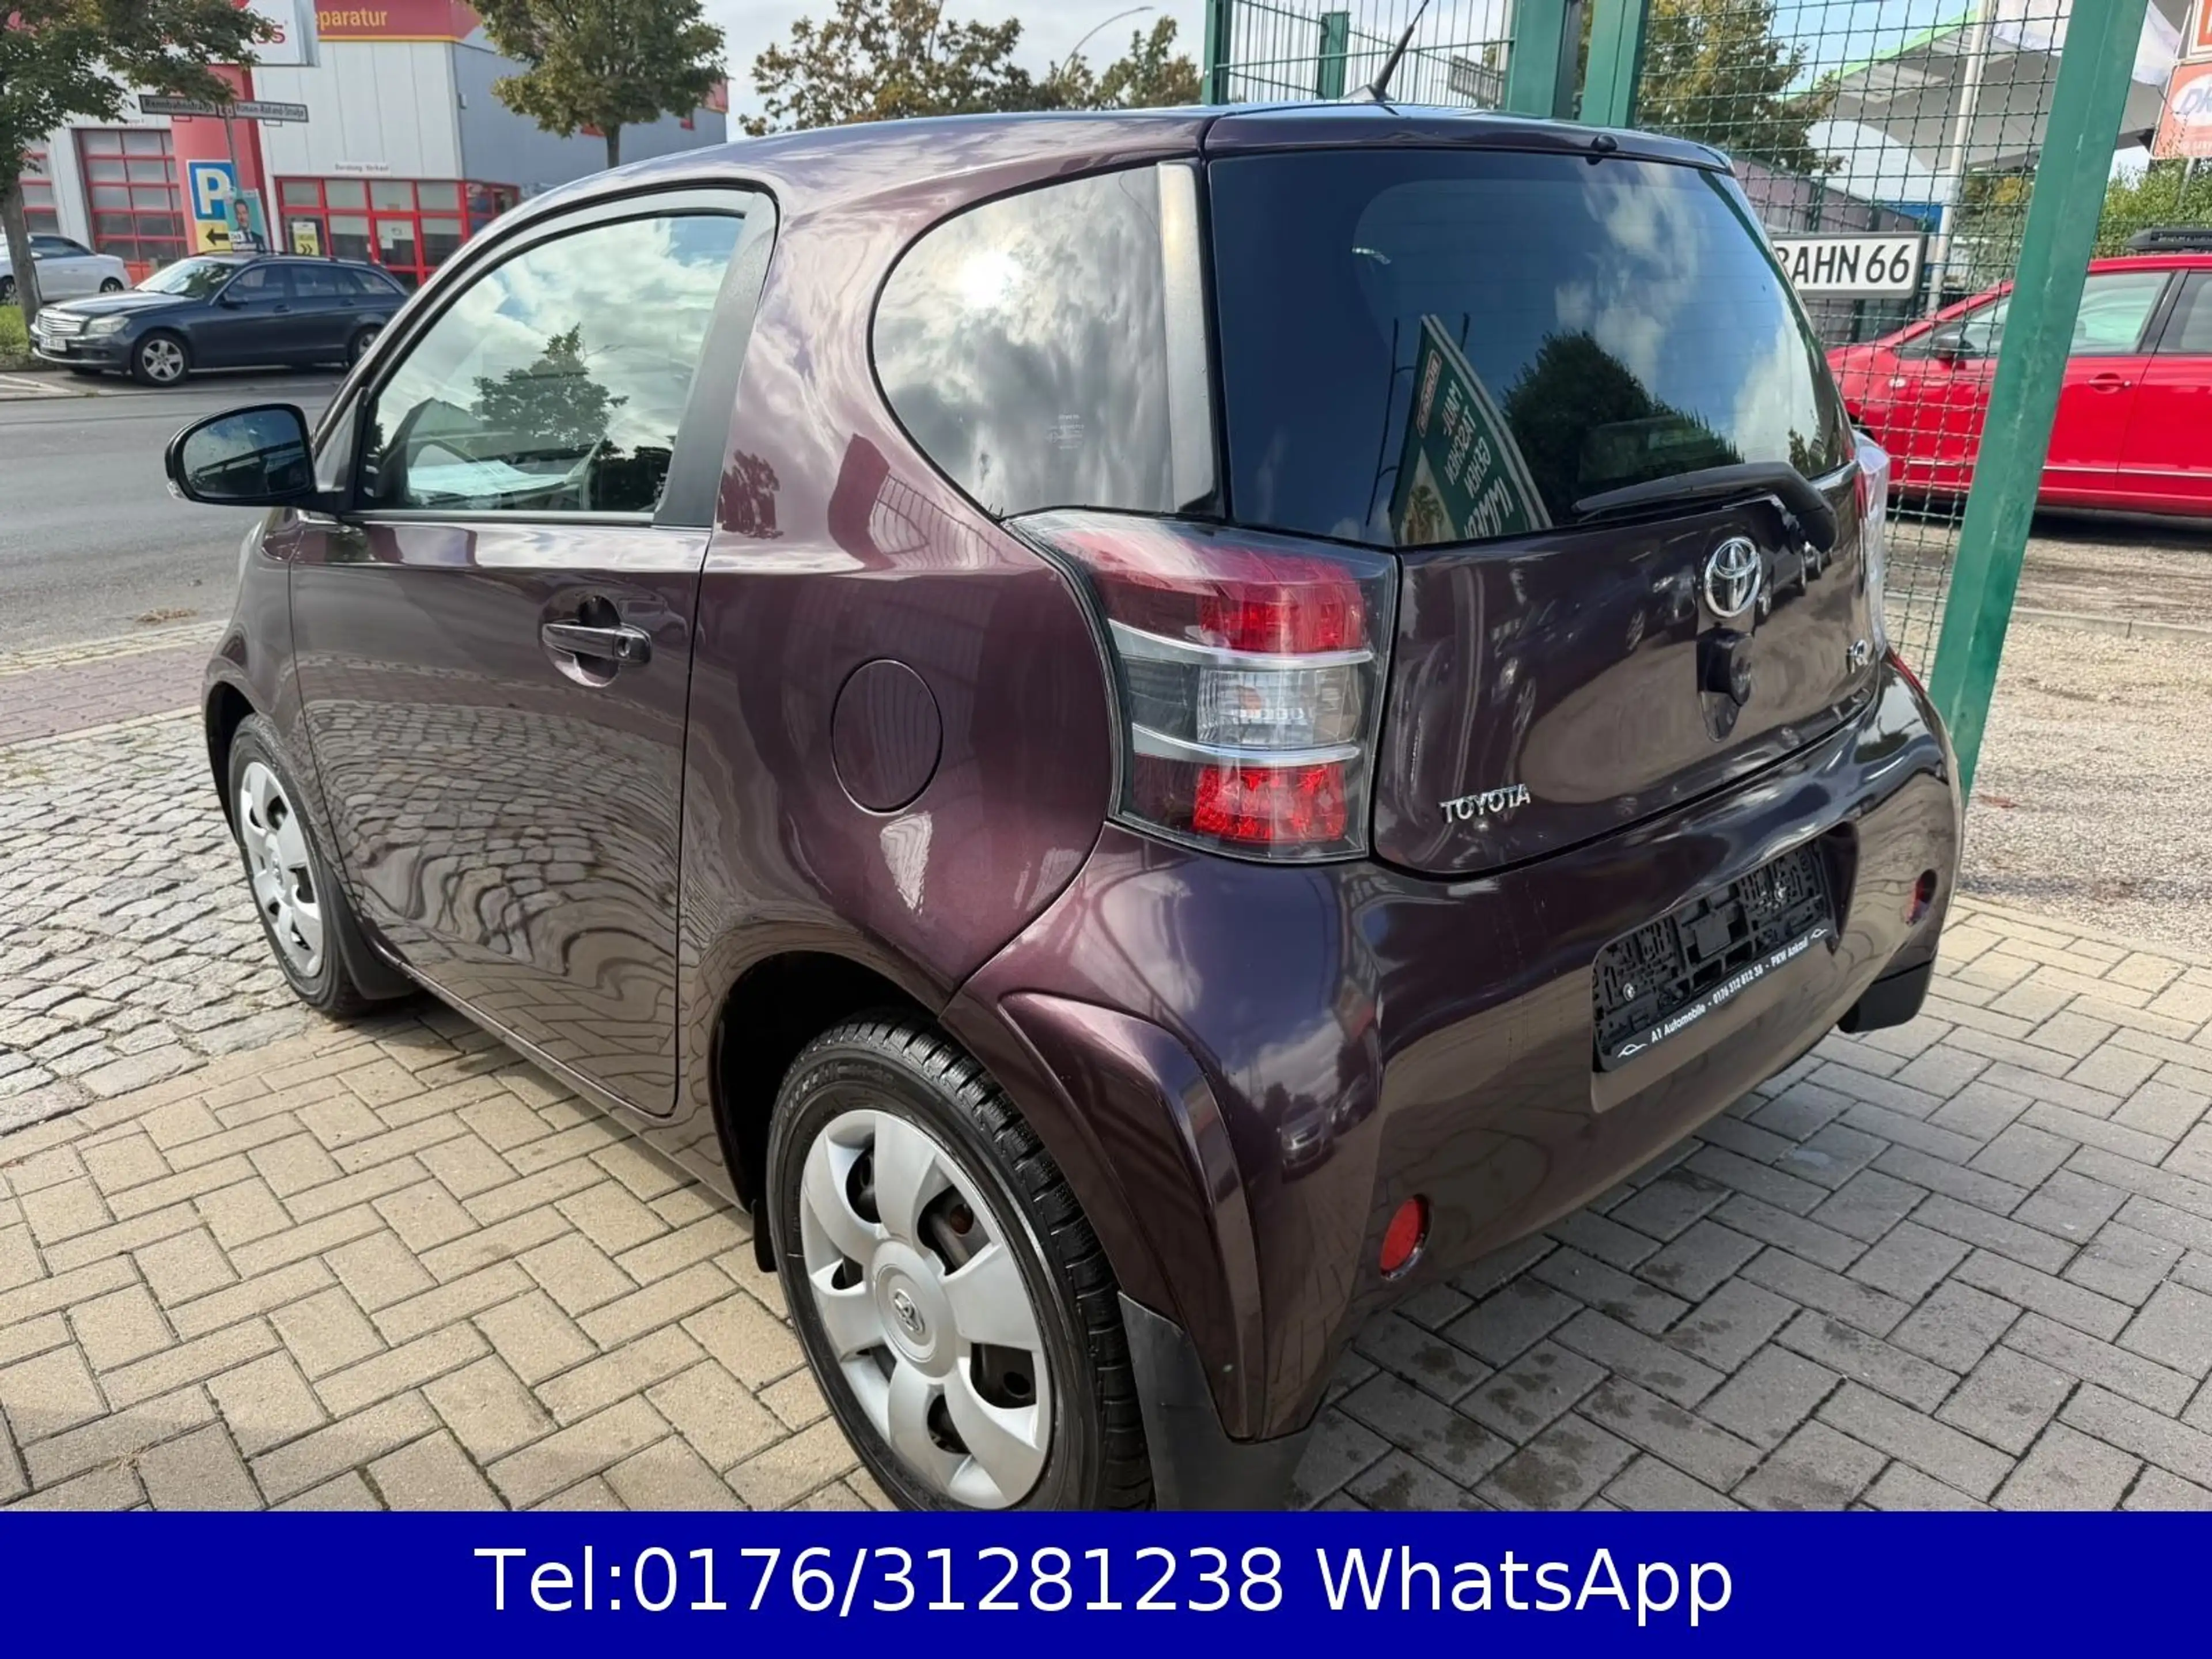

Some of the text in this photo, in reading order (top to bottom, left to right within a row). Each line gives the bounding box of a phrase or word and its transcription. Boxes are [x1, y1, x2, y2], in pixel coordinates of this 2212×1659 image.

[316, 8, 387, 31] paratur
[195, 168, 230, 214] P
[1866, 244, 1910, 283] 66
[1439, 784, 1531, 823] TOYOTA
[1652, 1027, 1662, 1043] A1
[1664, 1003, 1706, 1036] Automobile
[1713, 985, 1729, 1004] 0176
[1770, 949, 1787, 967] PKW
